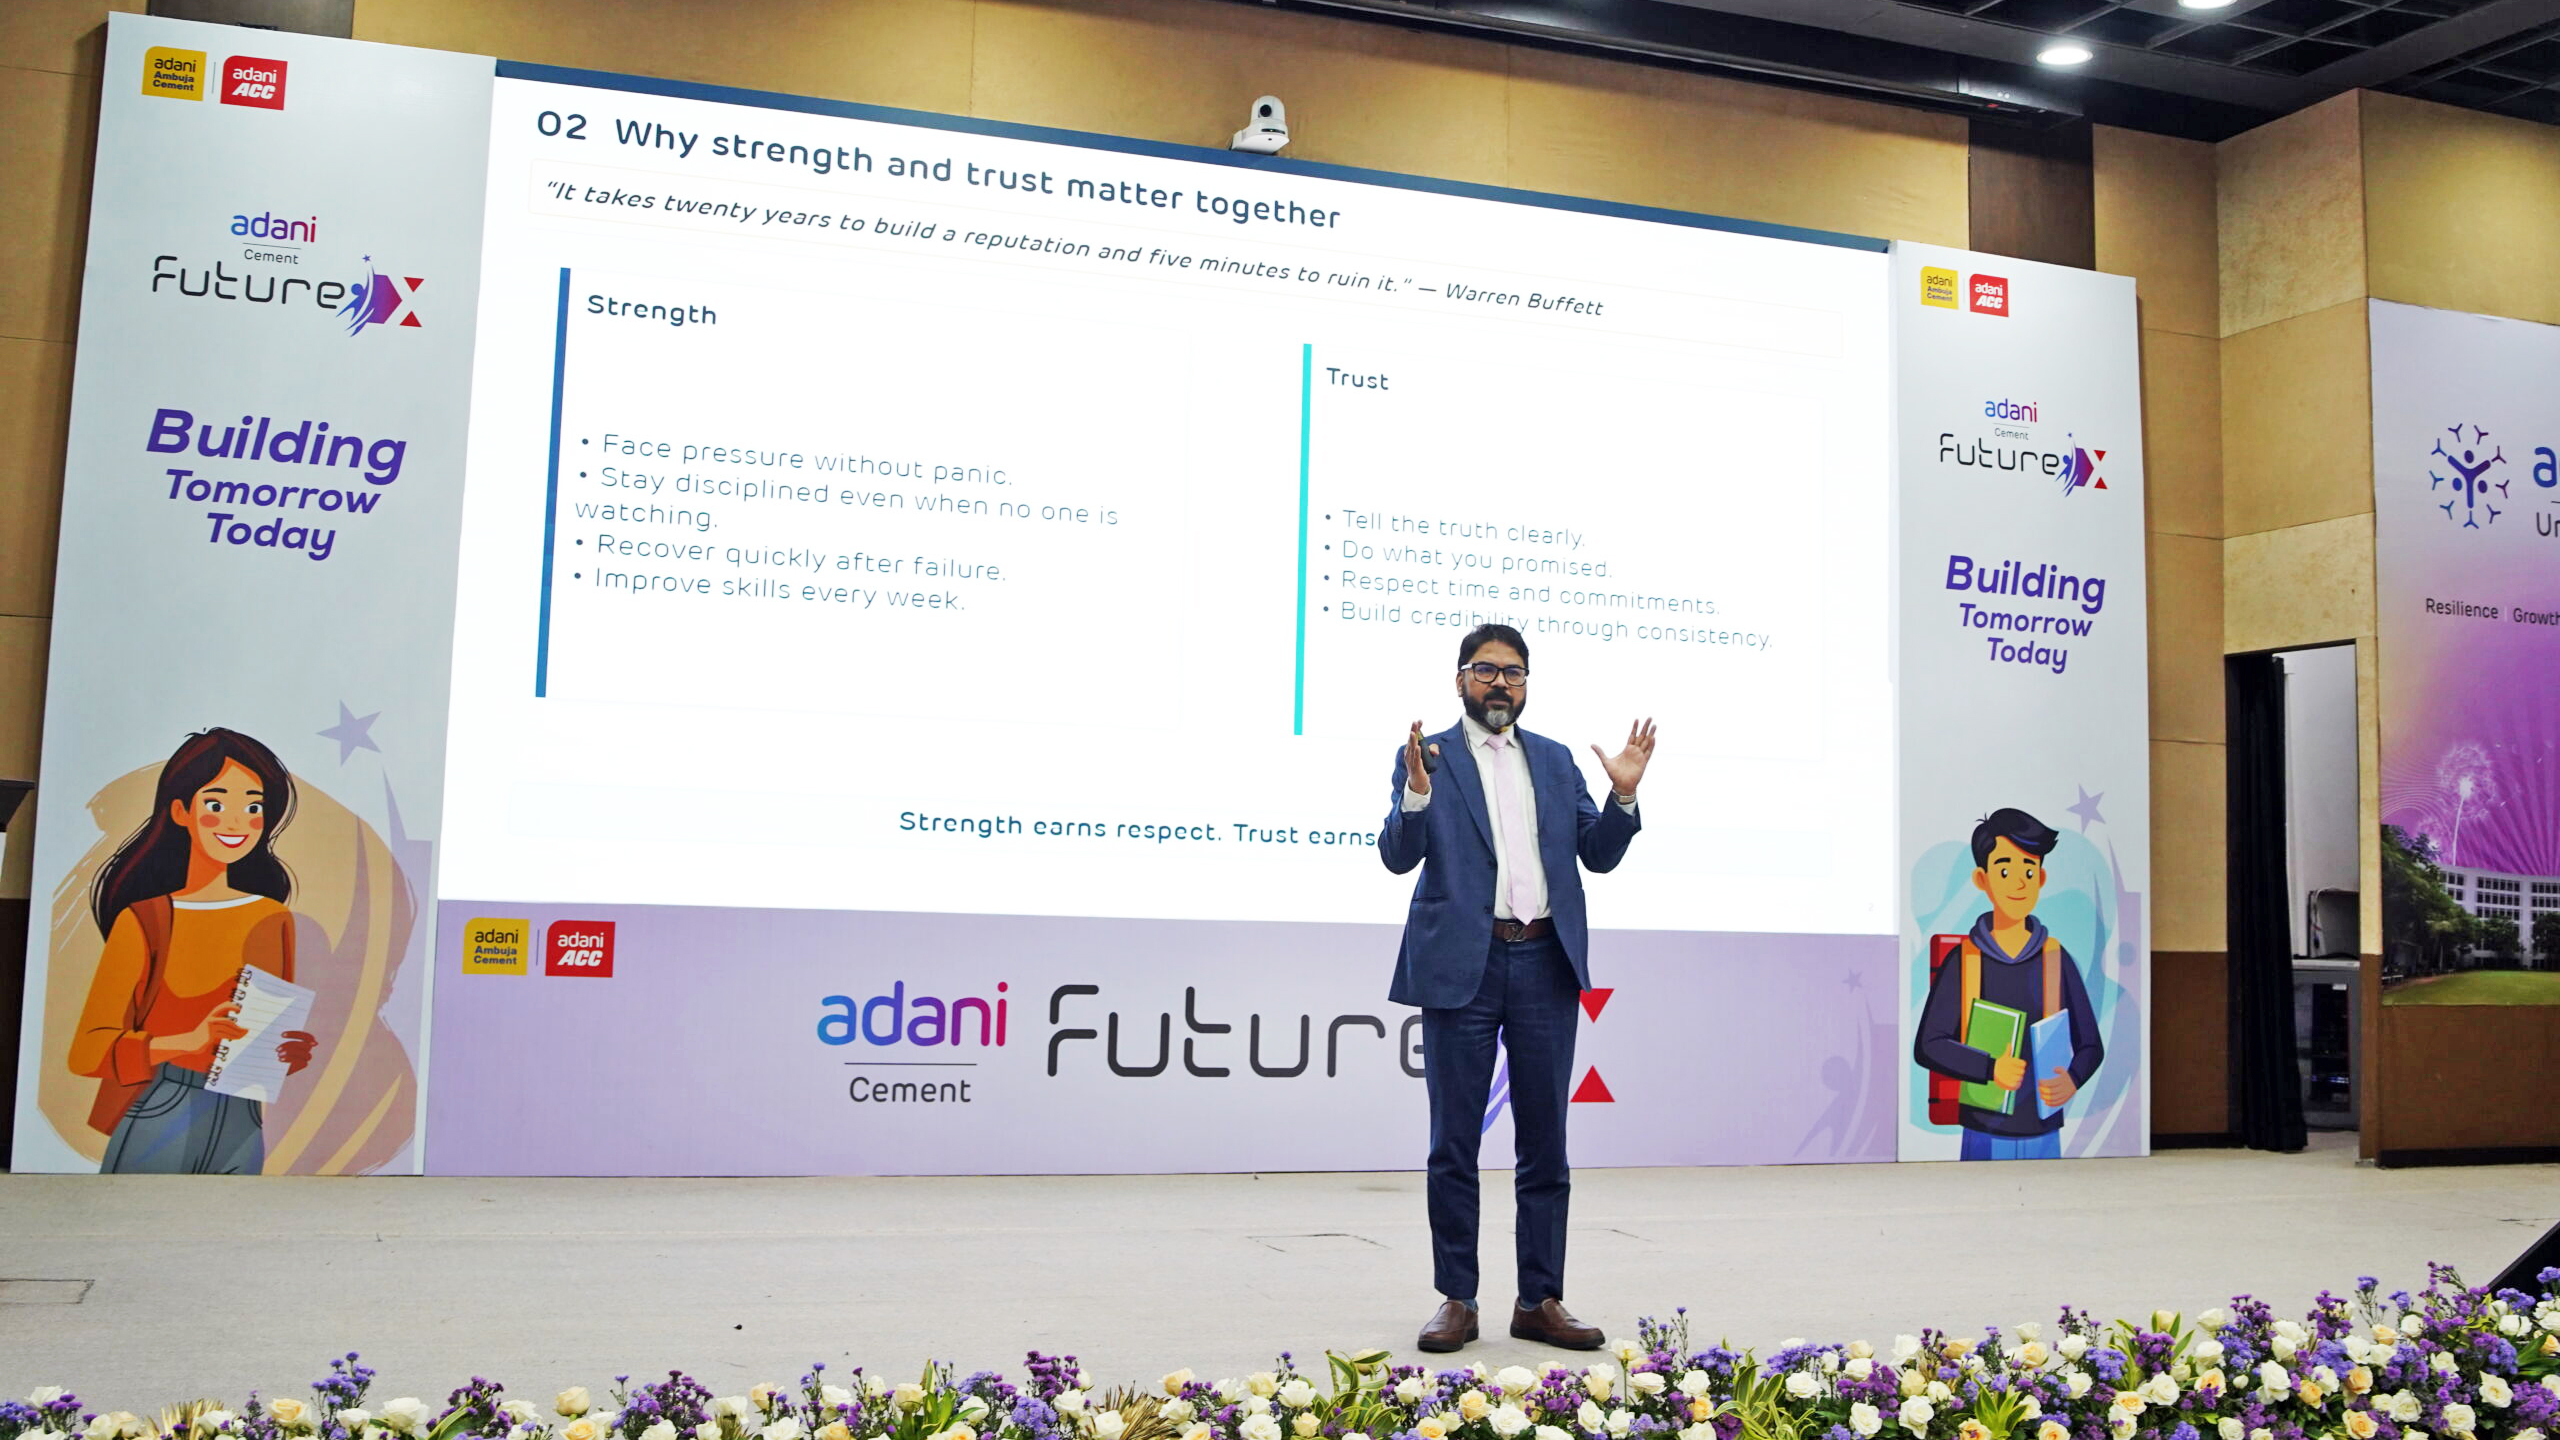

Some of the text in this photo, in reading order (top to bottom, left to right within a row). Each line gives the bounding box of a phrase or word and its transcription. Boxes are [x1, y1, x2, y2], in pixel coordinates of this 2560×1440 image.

[153, 71, 195, 83] Ambuja
[154, 57, 197, 73] adani
[232, 67, 277, 83] adani
[152, 80, 194, 91] Cement
[232, 82, 276, 99] ACC
[536, 109, 1342, 229] 02 Why strength and trust matter together
[231, 211, 317, 243] adani
[243, 248, 299, 264] Cement
[583, 185, 657, 209] takes
[663, 194, 758, 224] twenty
[761, 208, 833, 229] years
[839, 213, 866, 232] to
[873, 216, 938, 240] build
[941, 228, 957, 242] a
[963, 231, 1091, 258] reputation
[1097, 246, 1144, 263] and
[1148, 248, 1193, 269] five
[1199, 256, 1291, 280] minutes
[1297, 266, 1321, 283] to
[1327, 271, 1371, 290] ruin
[1446, 282, 1521, 307] Warren
[1527, 292, 1605, 317] Buffett
[1926, 275, 1953, 287] adani
[1974, 282, 2004, 296] adani
[586, 294, 717, 328] Strength
[1975, 295, 2004, 309] ACC
[1325, 366, 1390, 391] Trust
[1985, 398, 2038, 423] adani
[146, 408, 407, 485] Building
[1994, 427, 2029, 441] Cement
[603, 433, 1013, 486] Face pressure without panic.
[166, 468, 381, 514] Tomorrow
[600, 466, 1118, 526] Stay disciplined even when no one is
[574, 502, 718, 533] watching.
[1341, 509, 1585, 551] Tell the truth clearly.
[207, 512, 336, 561] Today
[597, 533, 1006, 582] Recover quickly after failure.
[1342, 539, 1613, 578] Do what you promised.
[595, 566, 965, 611] Improve skills every week.
[1342, 569, 1720, 615] Respect time and commitments.
[1946, 555, 2106, 614] Building
[1959, 603, 2094, 637] Tomorrow
[2425, 598, 2499, 619] Resilience
[1341, 600, 1401, 623] Build
[1537, 615, 1628, 642] through
[1636, 625, 1773, 652] consistency.
[1987, 637, 2068, 674] Today
[898, 810, 1377, 847] Strength earns respect. Trust earns
[474, 928, 519, 944] adani
[474, 945, 518, 957] Ambuja
[557, 931, 605, 948] adani
[473, 955, 518, 965] Cement
[557, 949, 603, 967] ACC
[816, 980, 1009, 1047] adani
[849, 1076, 972, 1103] Cement
